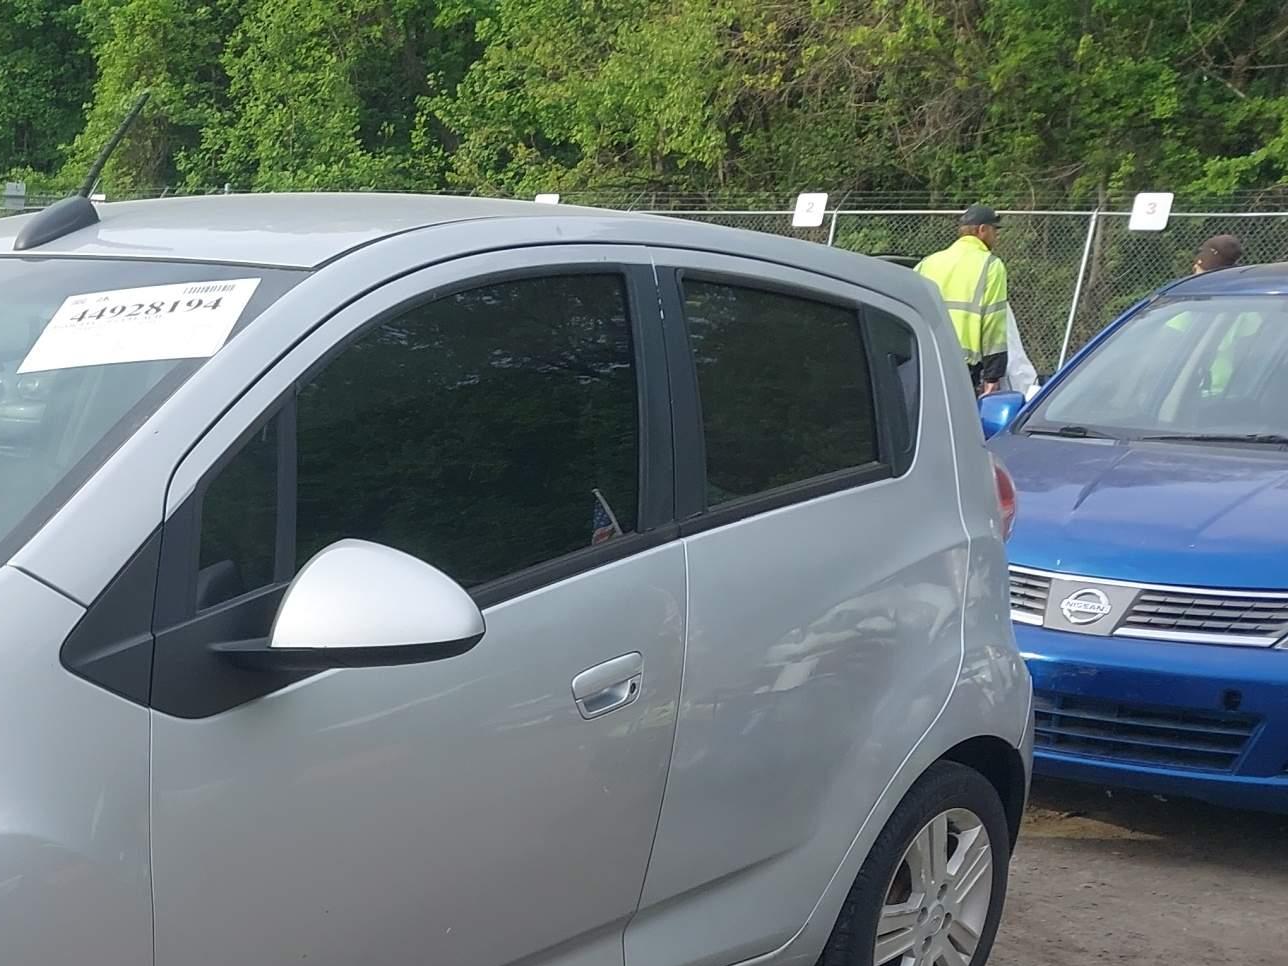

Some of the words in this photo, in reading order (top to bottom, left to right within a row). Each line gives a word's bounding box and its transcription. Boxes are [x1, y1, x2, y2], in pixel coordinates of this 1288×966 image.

[806, 201, 815, 214] 2
[1145, 201, 1158, 215] 3
[70, 297, 223, 322] 44928194
